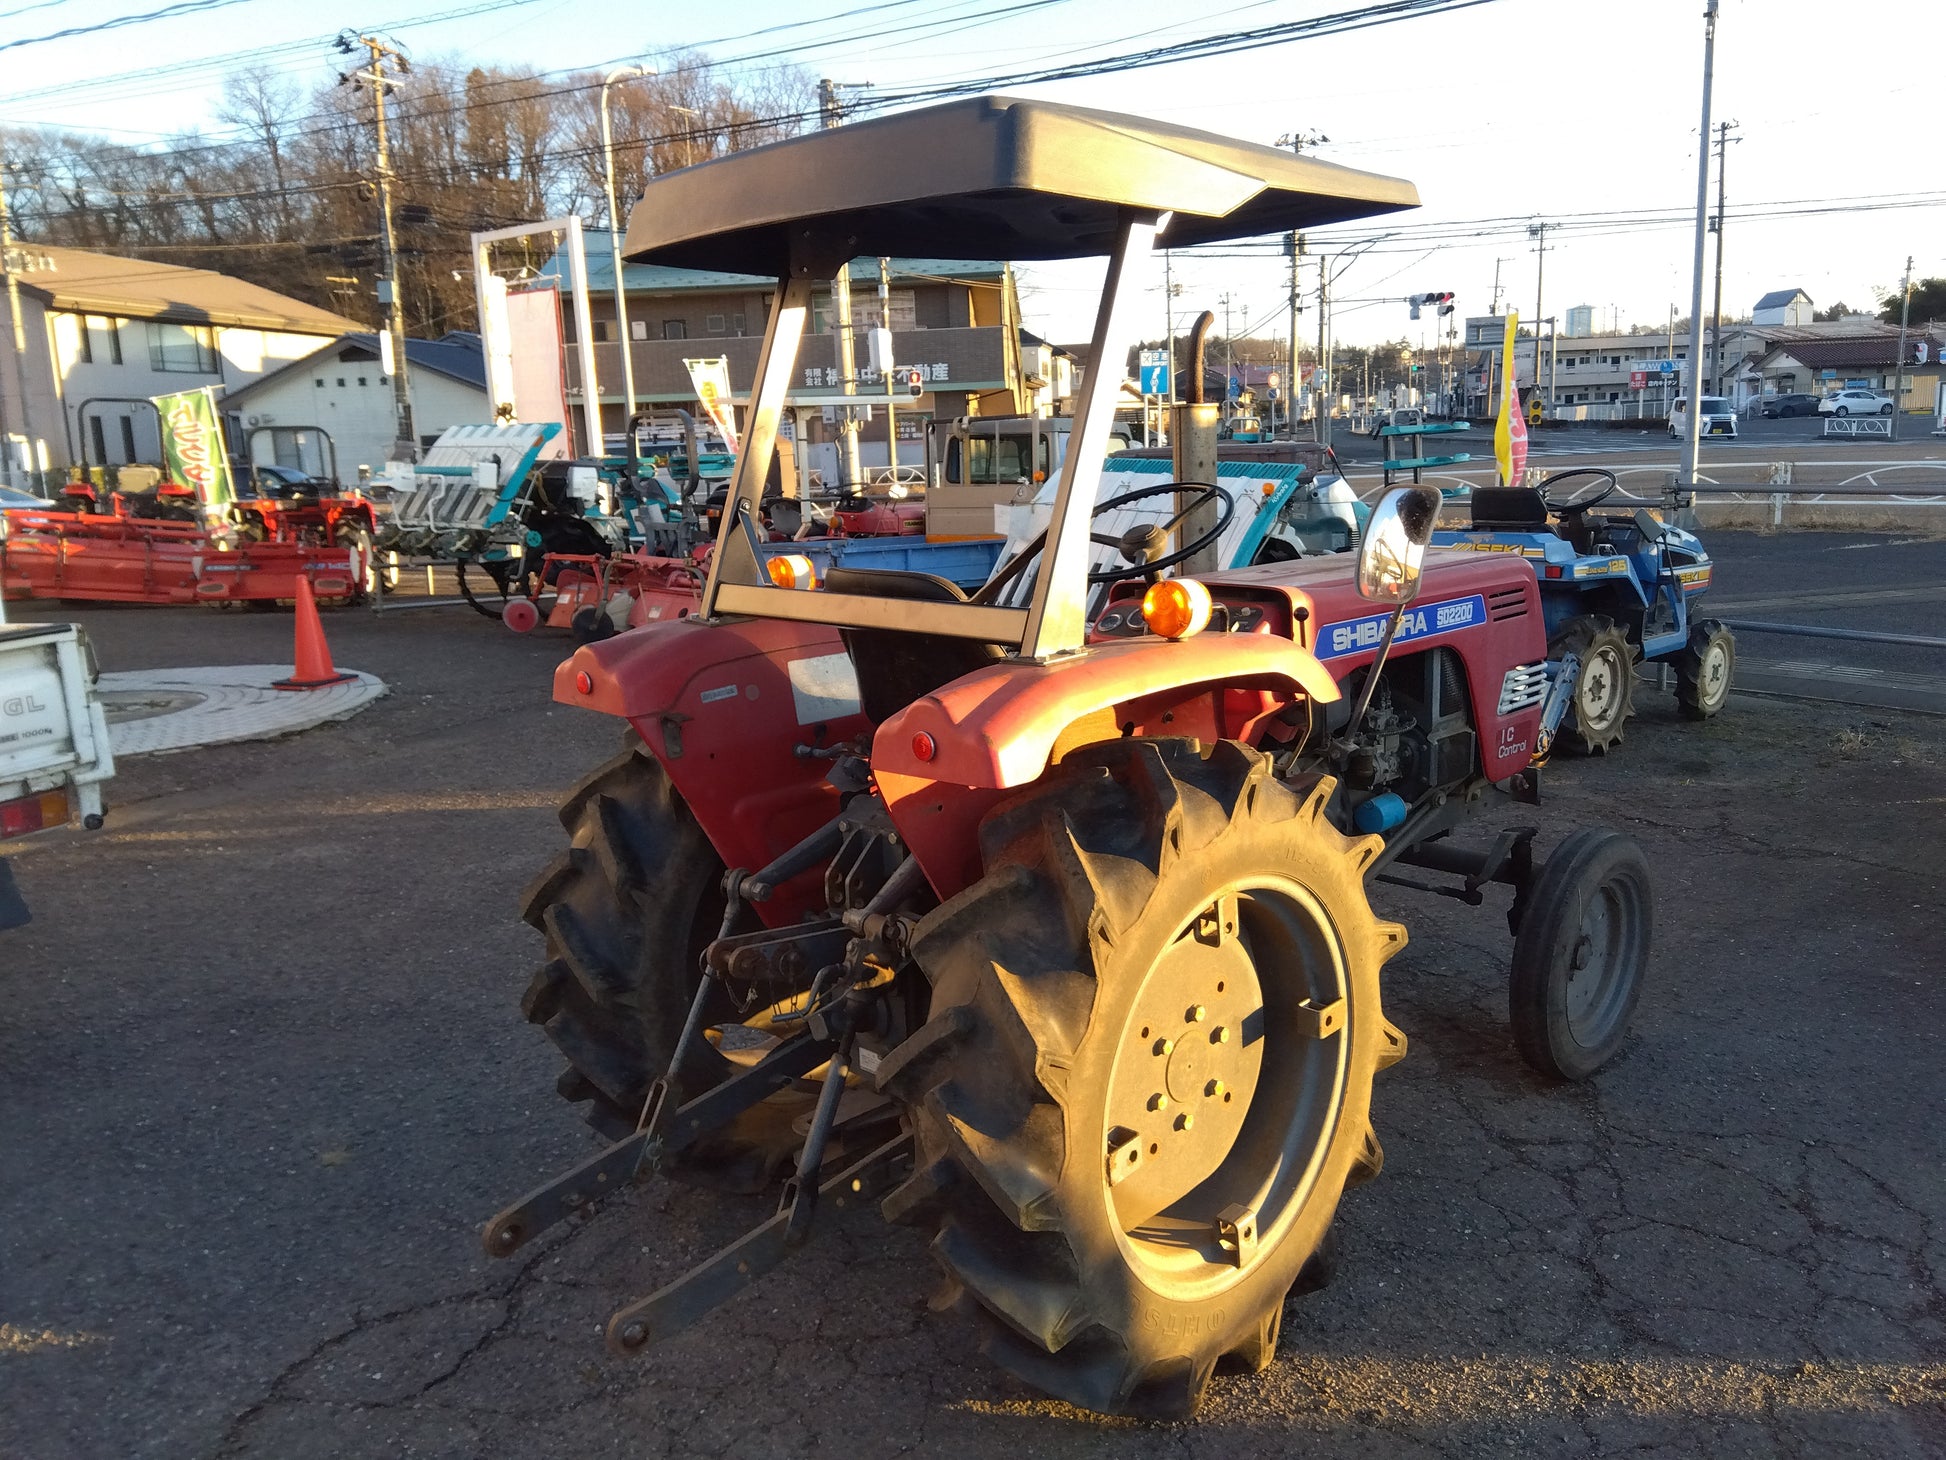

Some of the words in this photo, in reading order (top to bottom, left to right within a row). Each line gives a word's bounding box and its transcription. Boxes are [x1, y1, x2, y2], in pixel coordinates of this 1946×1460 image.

[1637, 361, 1680, 370] LAWN
[804, 368, 822, 377] 有限
[805, 377, 822, 386] 会社
[1471, 543, 1524, 556] ISEKI
[1608, 560, 1627, 572] 125
[1677, 573, 1699, 583] SEKI
[1332, 611, 1428, 652] SHIBARA
[1436, 602, 1474, 628] SD2200
[3, 695, 46, 717] GL
[1498, 739, 1527, 759] Control
